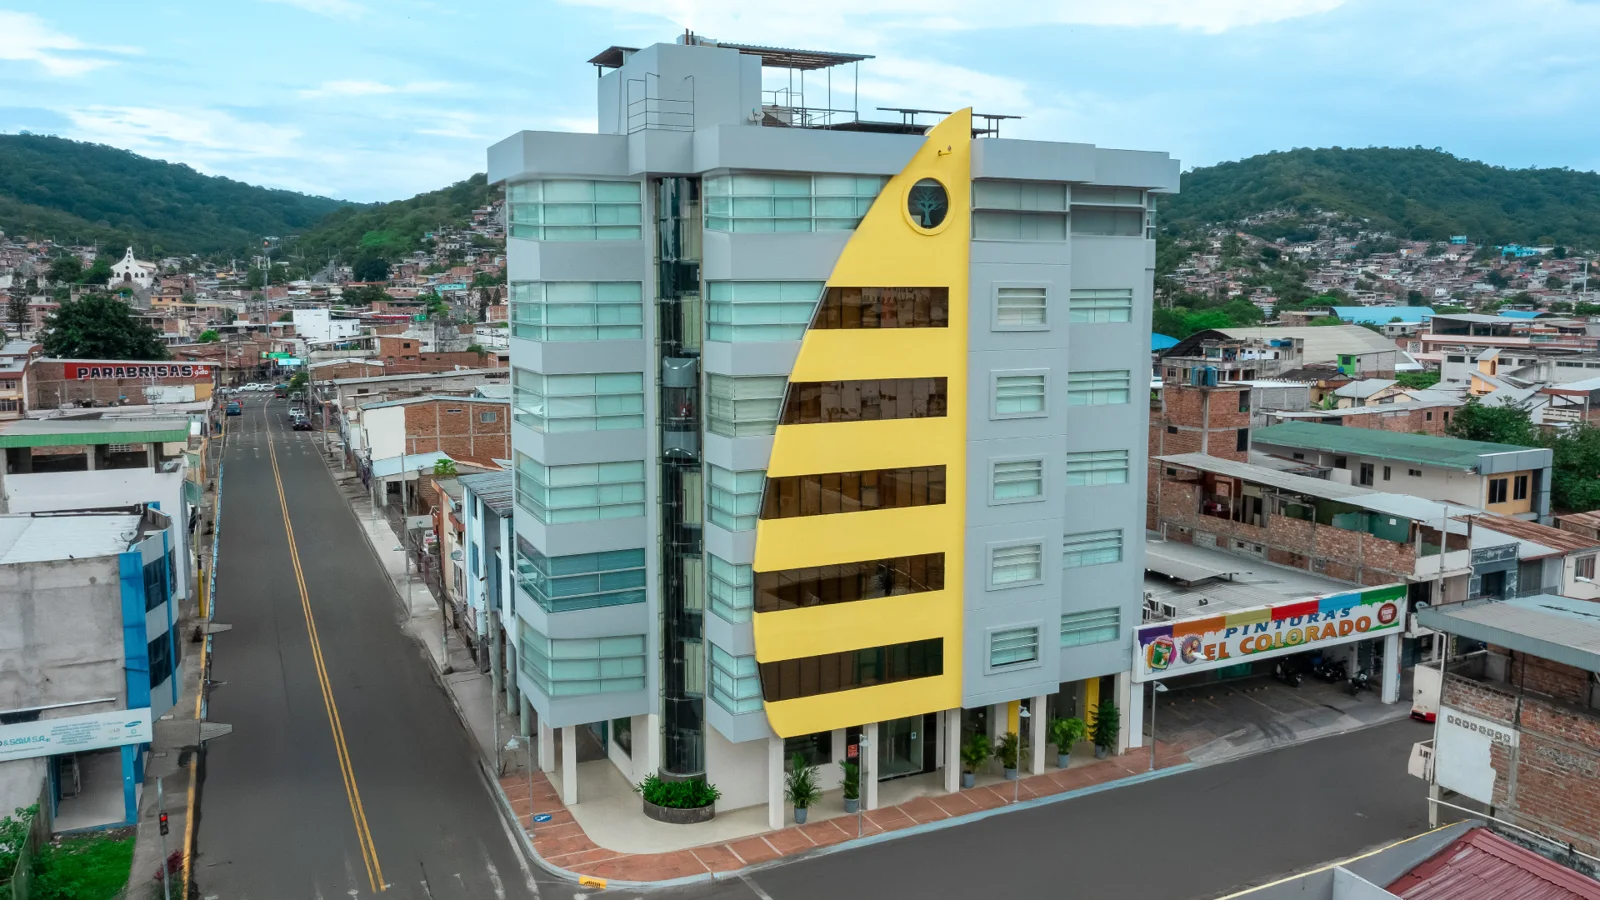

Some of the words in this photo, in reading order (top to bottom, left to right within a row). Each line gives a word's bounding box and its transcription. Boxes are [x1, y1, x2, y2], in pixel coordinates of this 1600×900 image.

[77, 365, 193, 380] PARABRISAS
[1224, 607, 1350, 638] PINTURAS
[1204, 642, 1229, 661] EL
[1239, 616, 1371, 654] COLORADO
